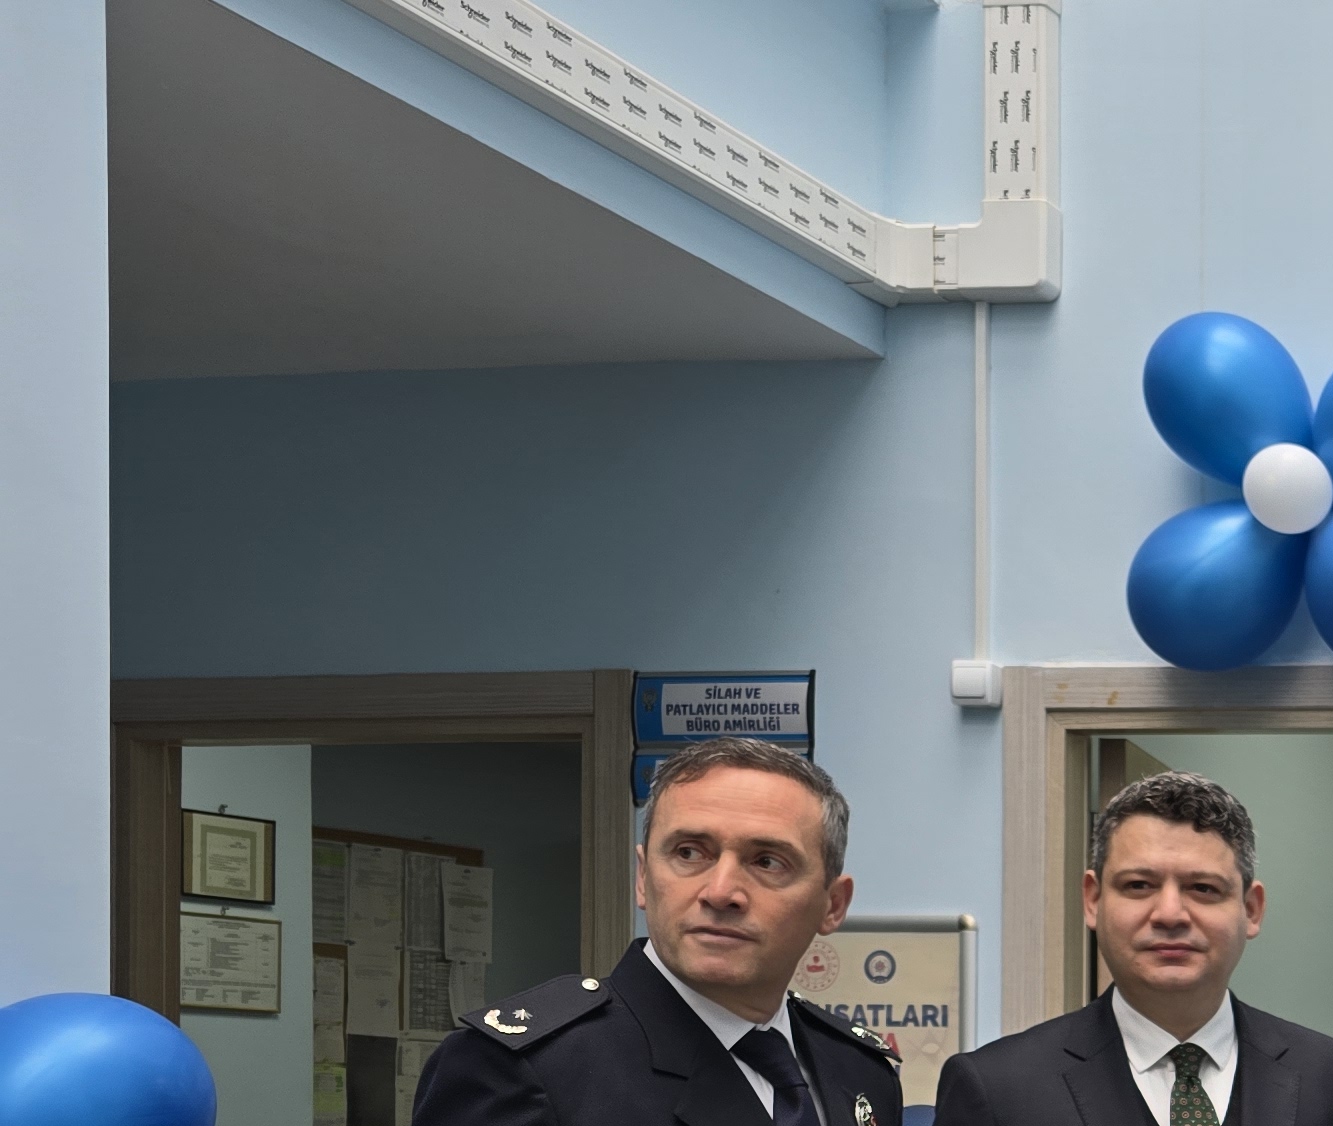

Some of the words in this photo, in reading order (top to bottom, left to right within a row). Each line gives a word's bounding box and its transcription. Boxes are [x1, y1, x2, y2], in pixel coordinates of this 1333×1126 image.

[705, 686, 742, 699] SİLAH
[745, 688, 761, 699] VE
[666, 703, 728, 716] PATLAYICI
[731, 703, 800, 715] MADDELER
[686, 717, 721, 731] BÜRO
[724, 716, 781, 731] AMİRLİĞİ
